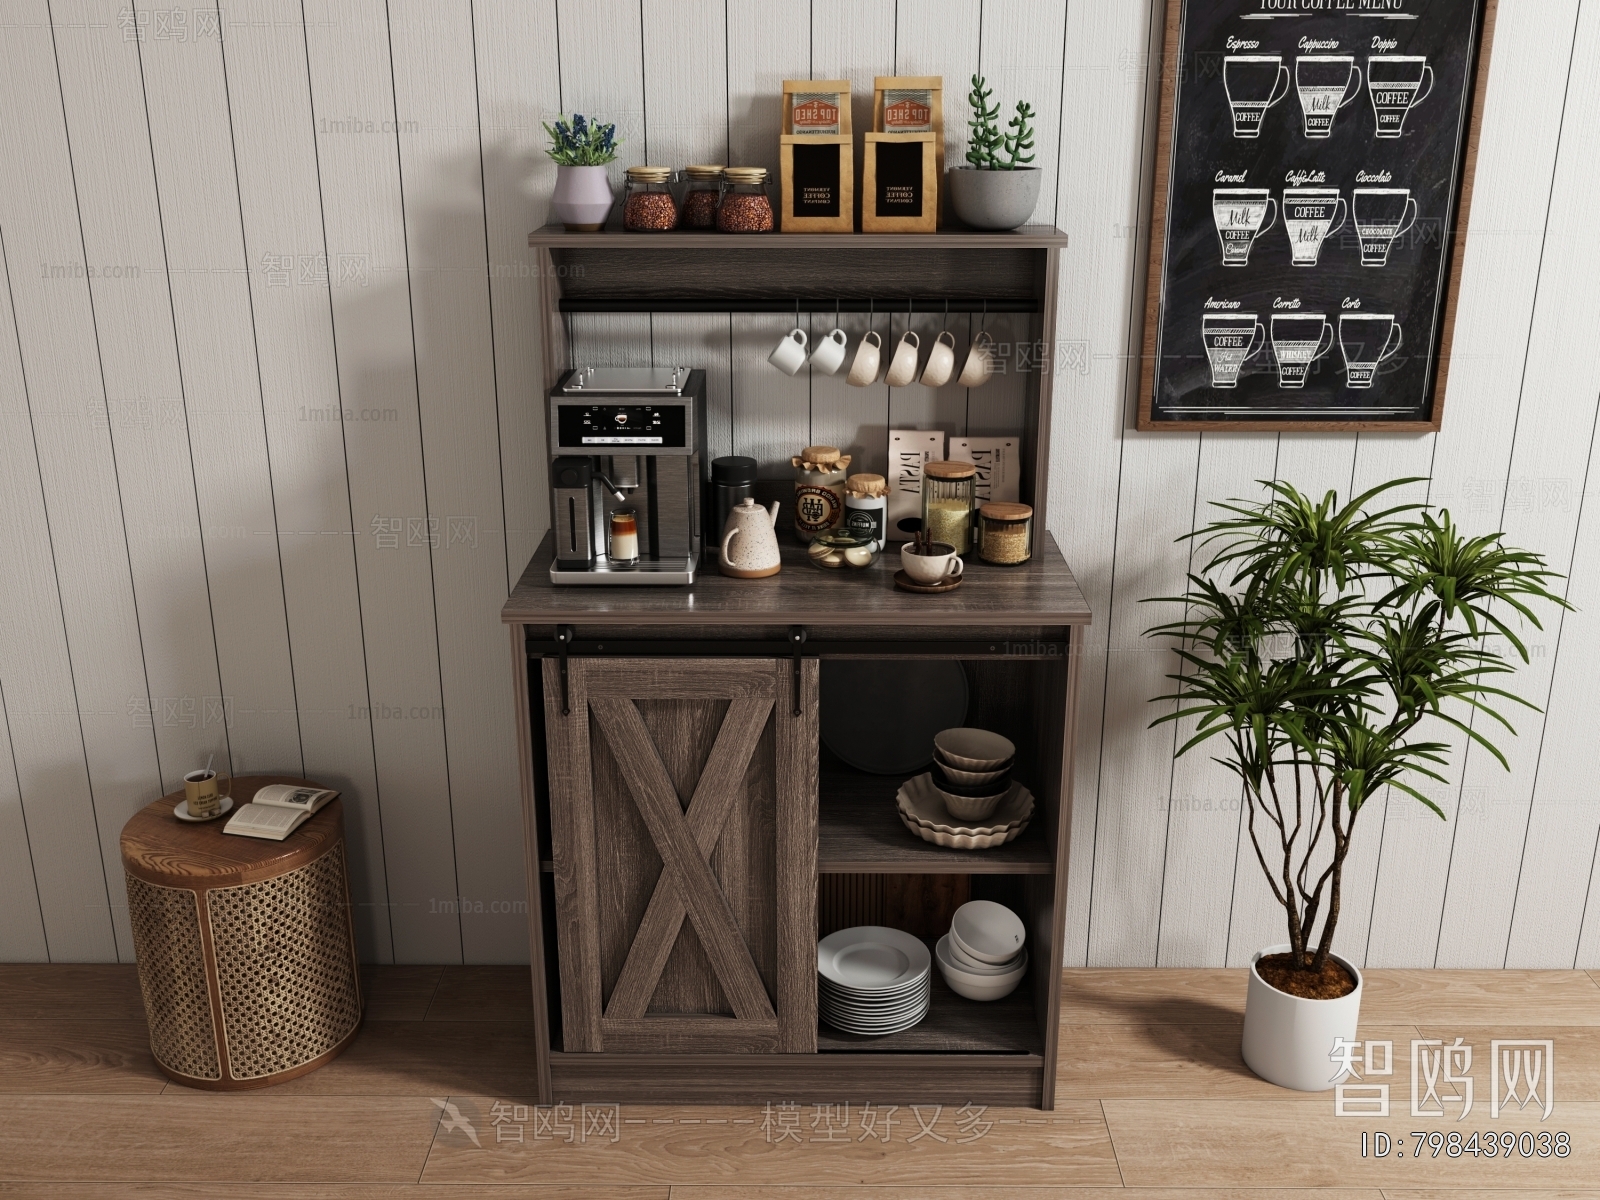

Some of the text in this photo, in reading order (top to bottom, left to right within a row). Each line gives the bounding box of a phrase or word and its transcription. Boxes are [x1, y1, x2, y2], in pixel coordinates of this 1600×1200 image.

[1226, 36, 1260, 52] Espresso
[1298, 35, 1340, 53] Cappuccino
[1371, 35, 1398, 53] Doppio
[1309, 94, 1332, 112] Milk
[1376, 92, 1410, 105] COFFEE
[1235, 112, 1261, 122] COFFEE
[1307, 118, 1330, 127] COFFEE
[1379, 114, 1400, 123] COFFEE
[1214, 169, 1248, 183] Caramel
[1355, 169, 1392, 183] Cioccolato
[1227, 207, 1251, 226] Milk
[1294, 206, 1326, 218] COFFEE
[1225, 230, 1250, 240] COFFEE
[1297, 225, 1319, 243] Milk
[1361, 228, 1393, 236] CHOCOLATE
[1363, 243, 1387, 253] COFFEE
[1203, 296, 1241, 309] Americano
[1272, 296, 1302, 309] Corretto
[1341, 296, 1361, 309] Corto
[1213, 336, 1243, 347] COFFEE
[1281, 366, 1305, 376] COFFEE
[1350, 371, 1371, 379] COFFEE
